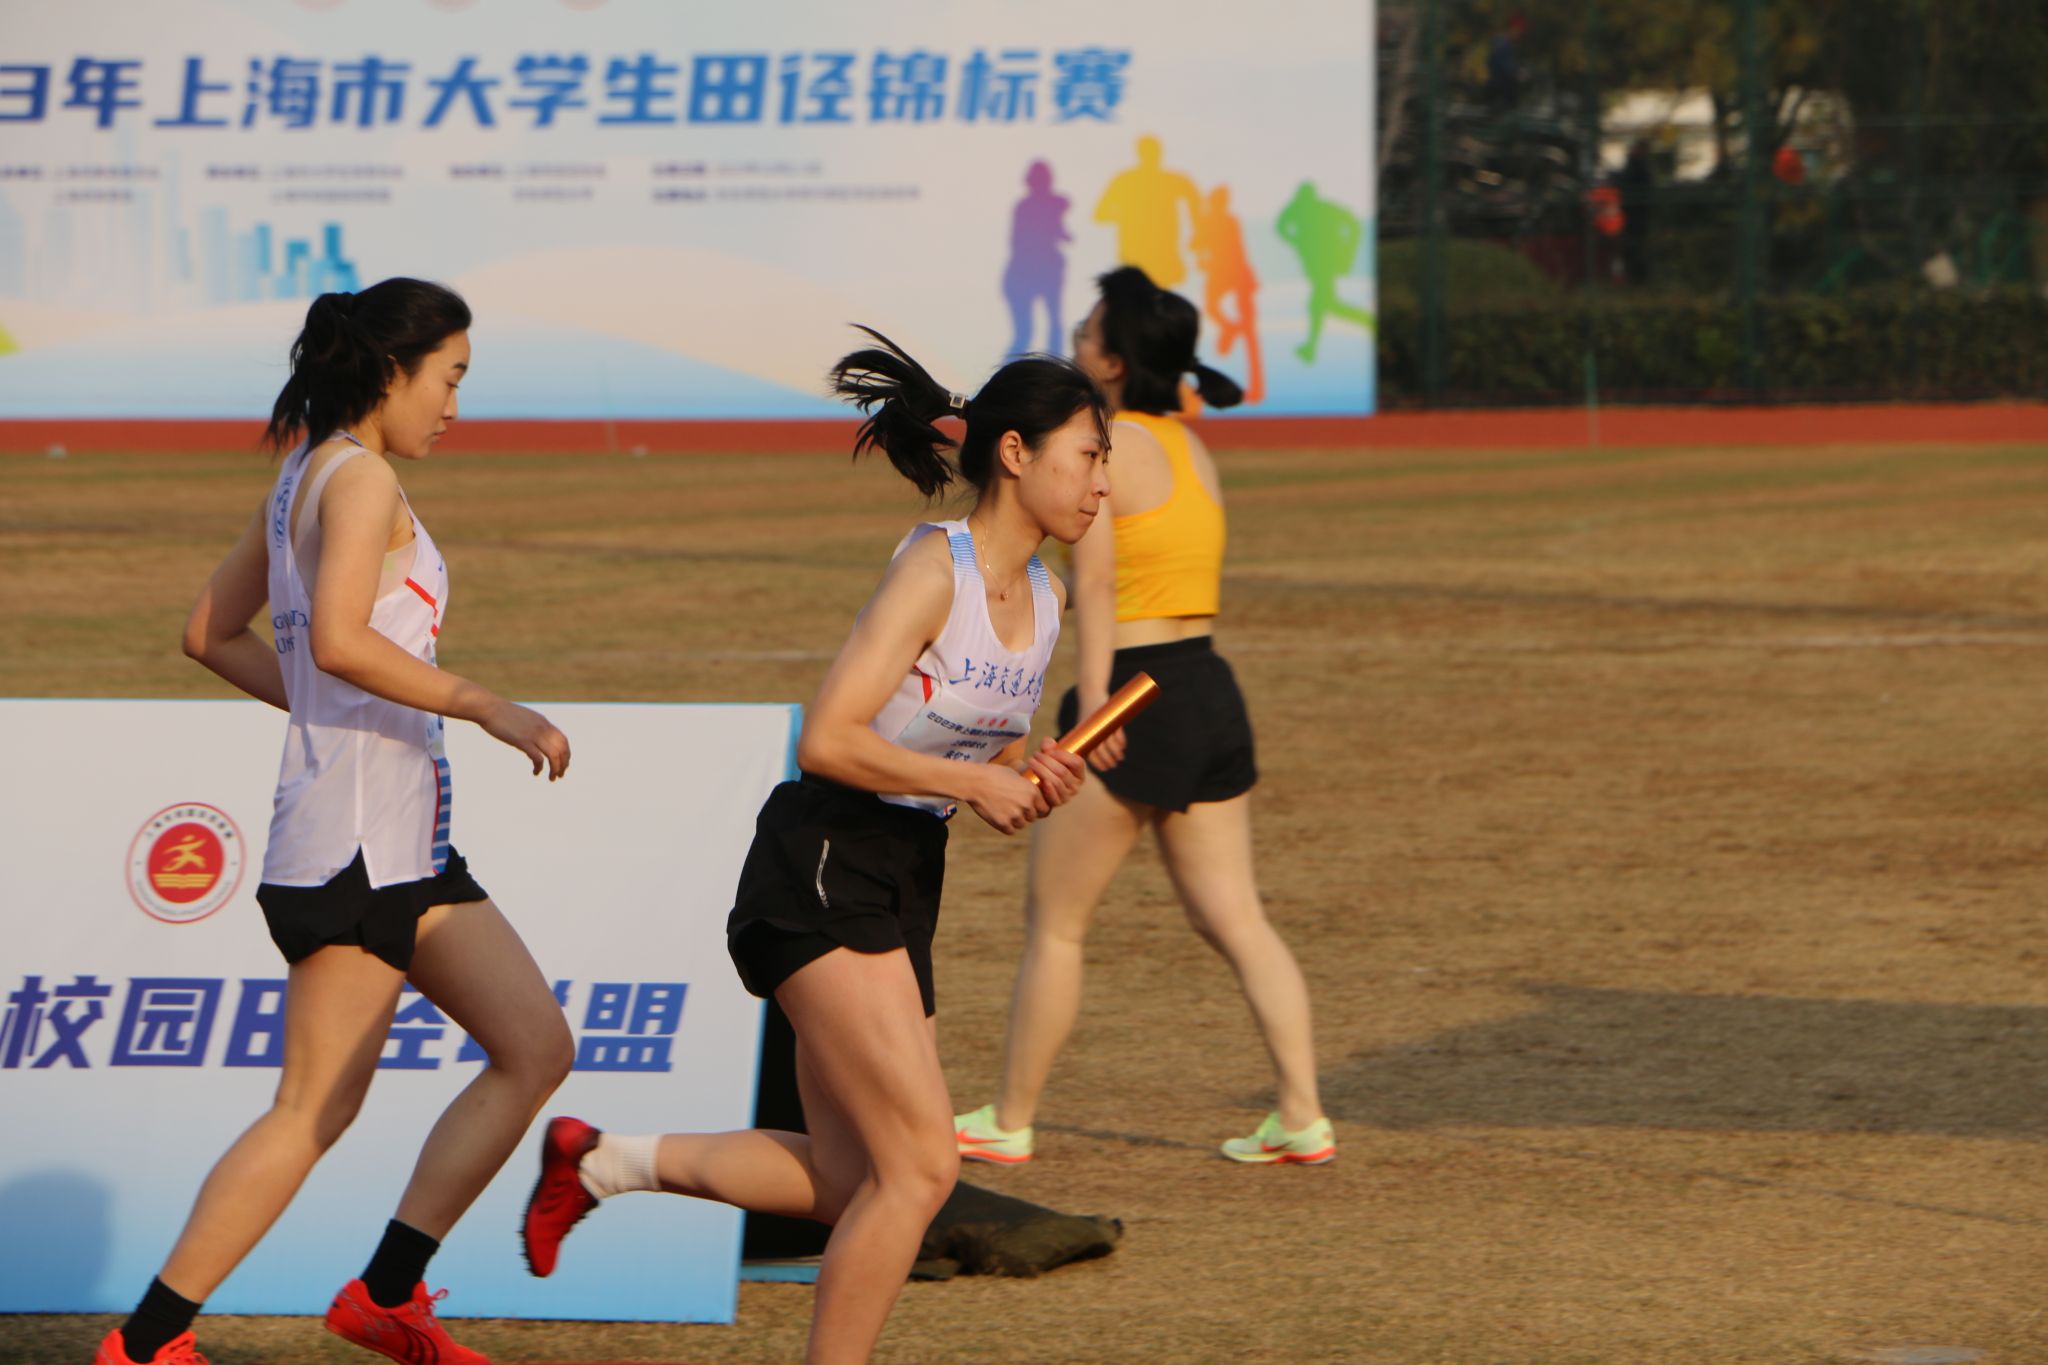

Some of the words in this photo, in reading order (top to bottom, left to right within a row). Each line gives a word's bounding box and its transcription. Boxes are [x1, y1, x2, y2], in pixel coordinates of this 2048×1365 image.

[0, 47, 1131, 129] 3年上海市大学生田径锦标赛
